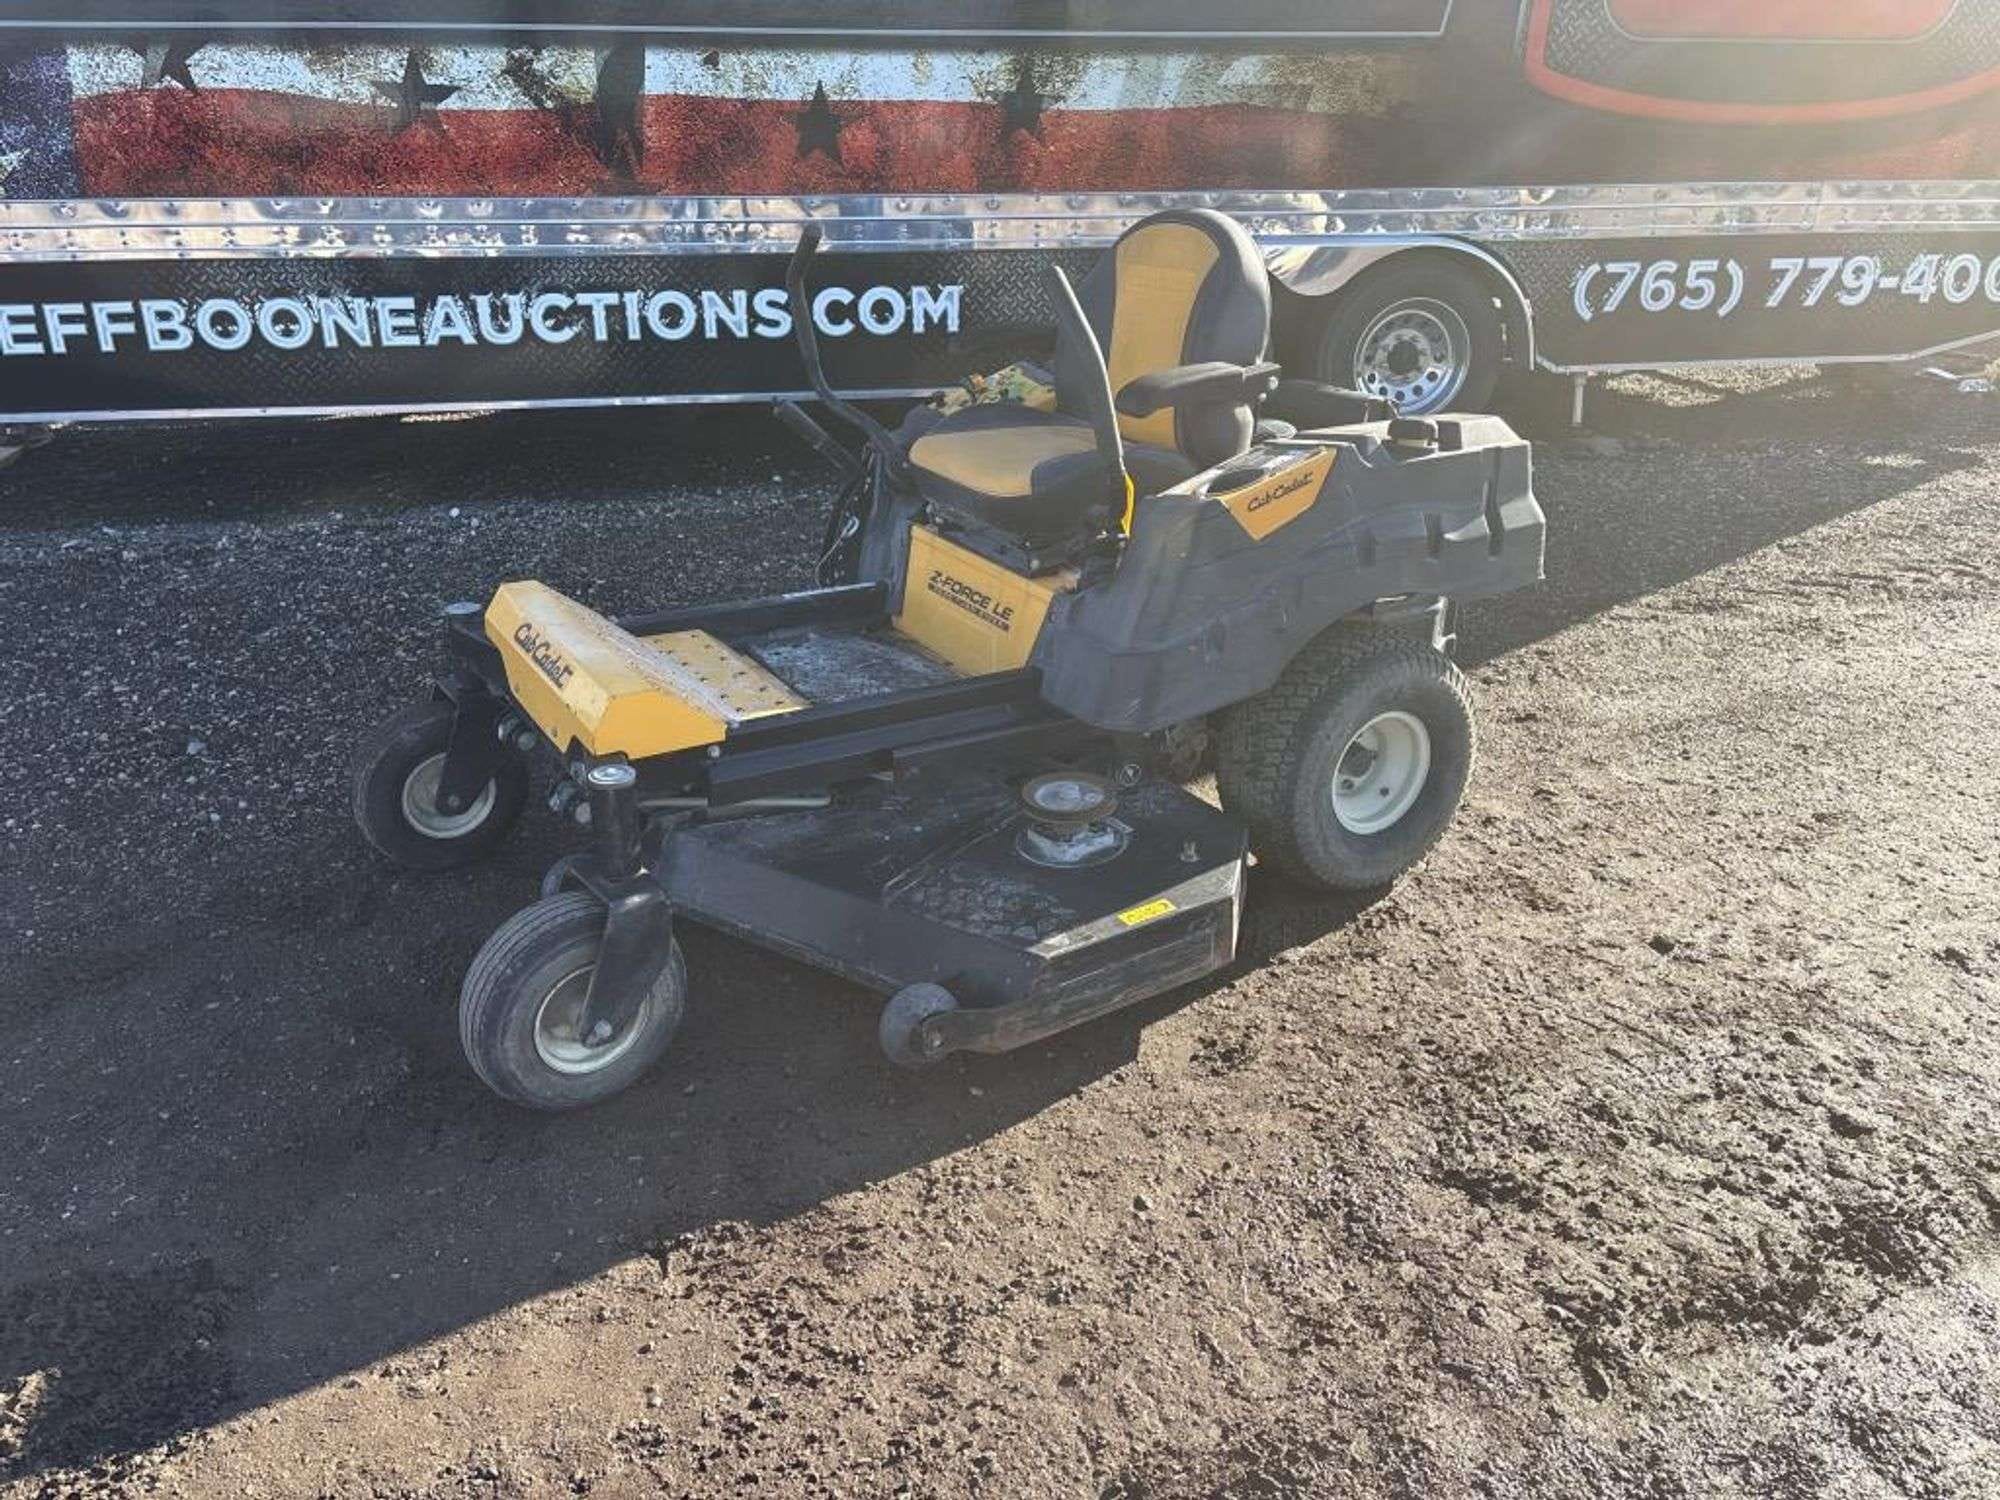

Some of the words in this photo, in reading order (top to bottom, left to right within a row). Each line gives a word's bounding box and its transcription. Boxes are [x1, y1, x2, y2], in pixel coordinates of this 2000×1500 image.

[0, 284, 963, 355] EFFBOONEAUCTIONSCOM
[1573, 258, 1745, 322] (765)
[929, 570, 992, 609] Z-FORCE
[992, 602, 1015, 621] LE
[514, 623, 540, 655] Cub
[532, 640, 574, 689] Cadet
